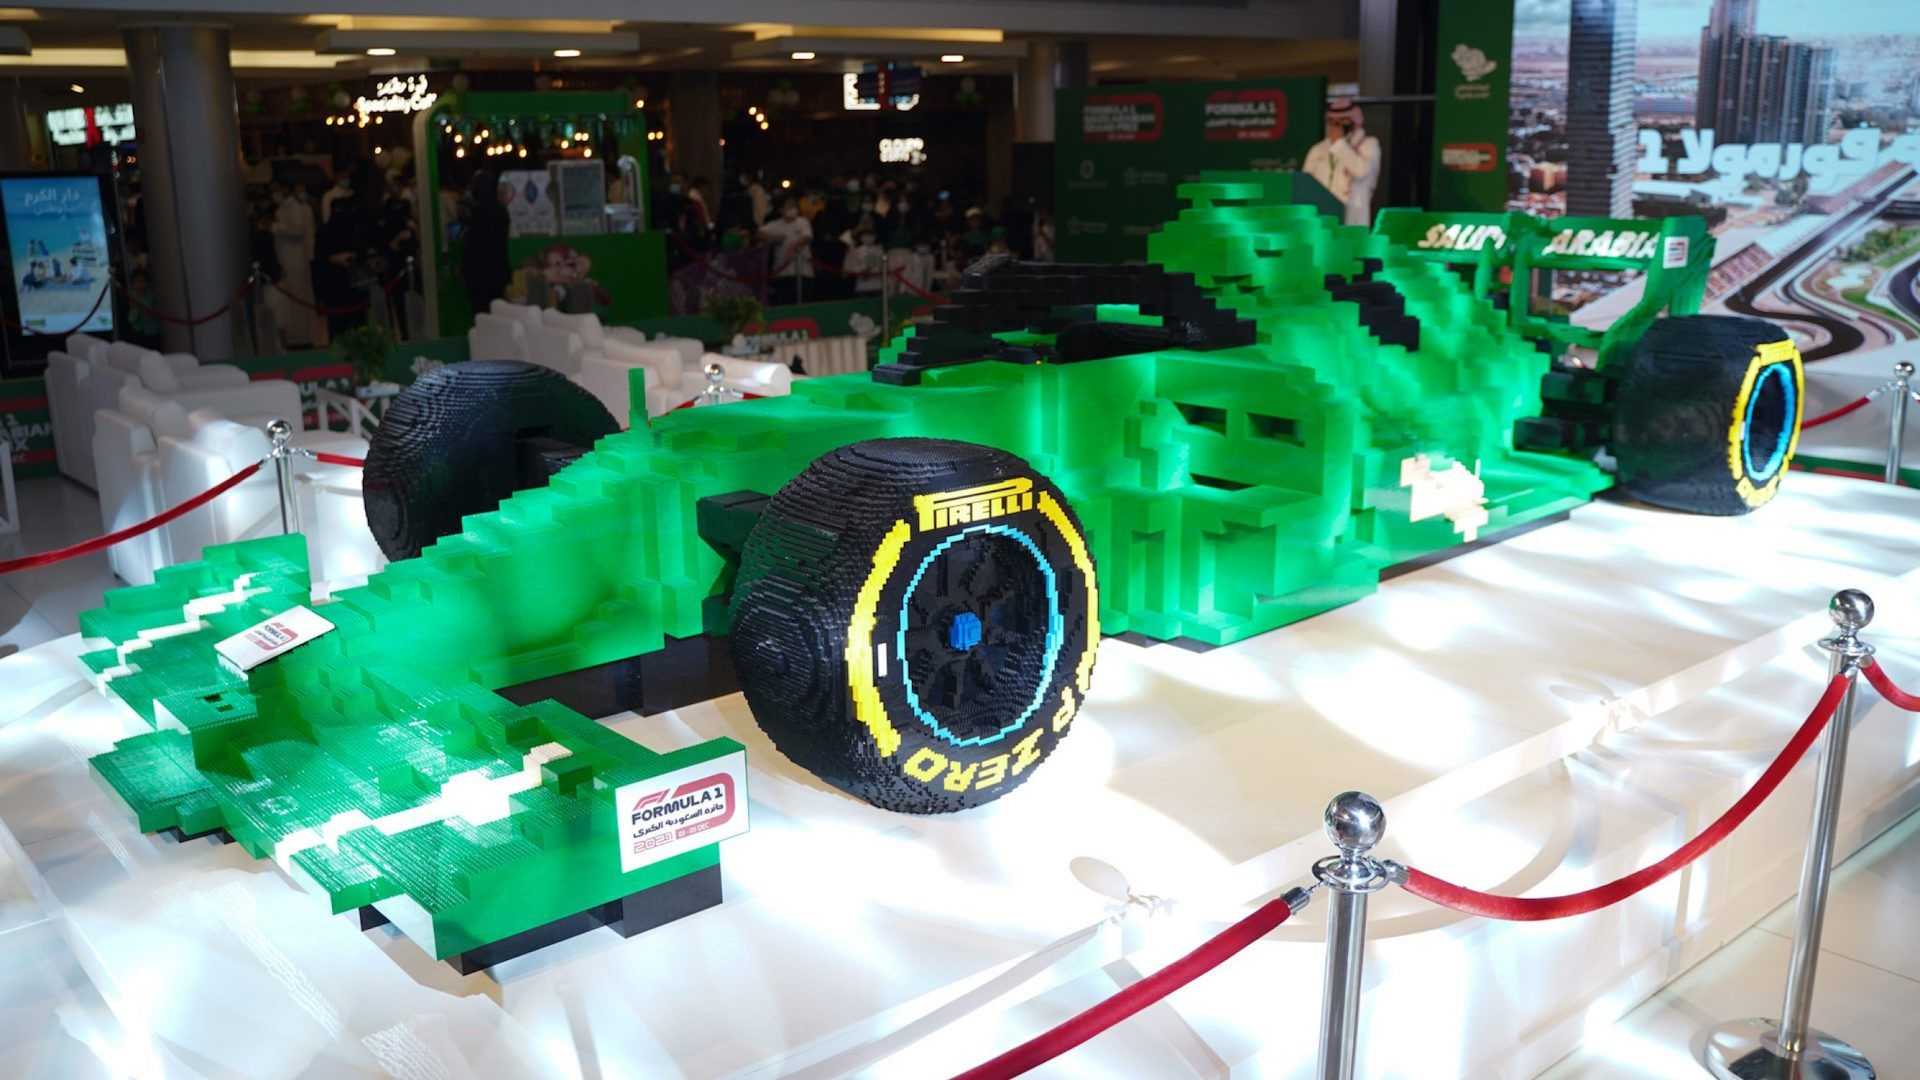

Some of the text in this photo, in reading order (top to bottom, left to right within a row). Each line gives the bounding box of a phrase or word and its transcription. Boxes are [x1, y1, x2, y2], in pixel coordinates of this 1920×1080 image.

[1541, 228, 1660, 258] ARABIA
[913, 477, 1033, 532] PIRELLI
[904, 728, 1044, 792] ZERO
[631, 786, 724, 826] FORMULA 1
